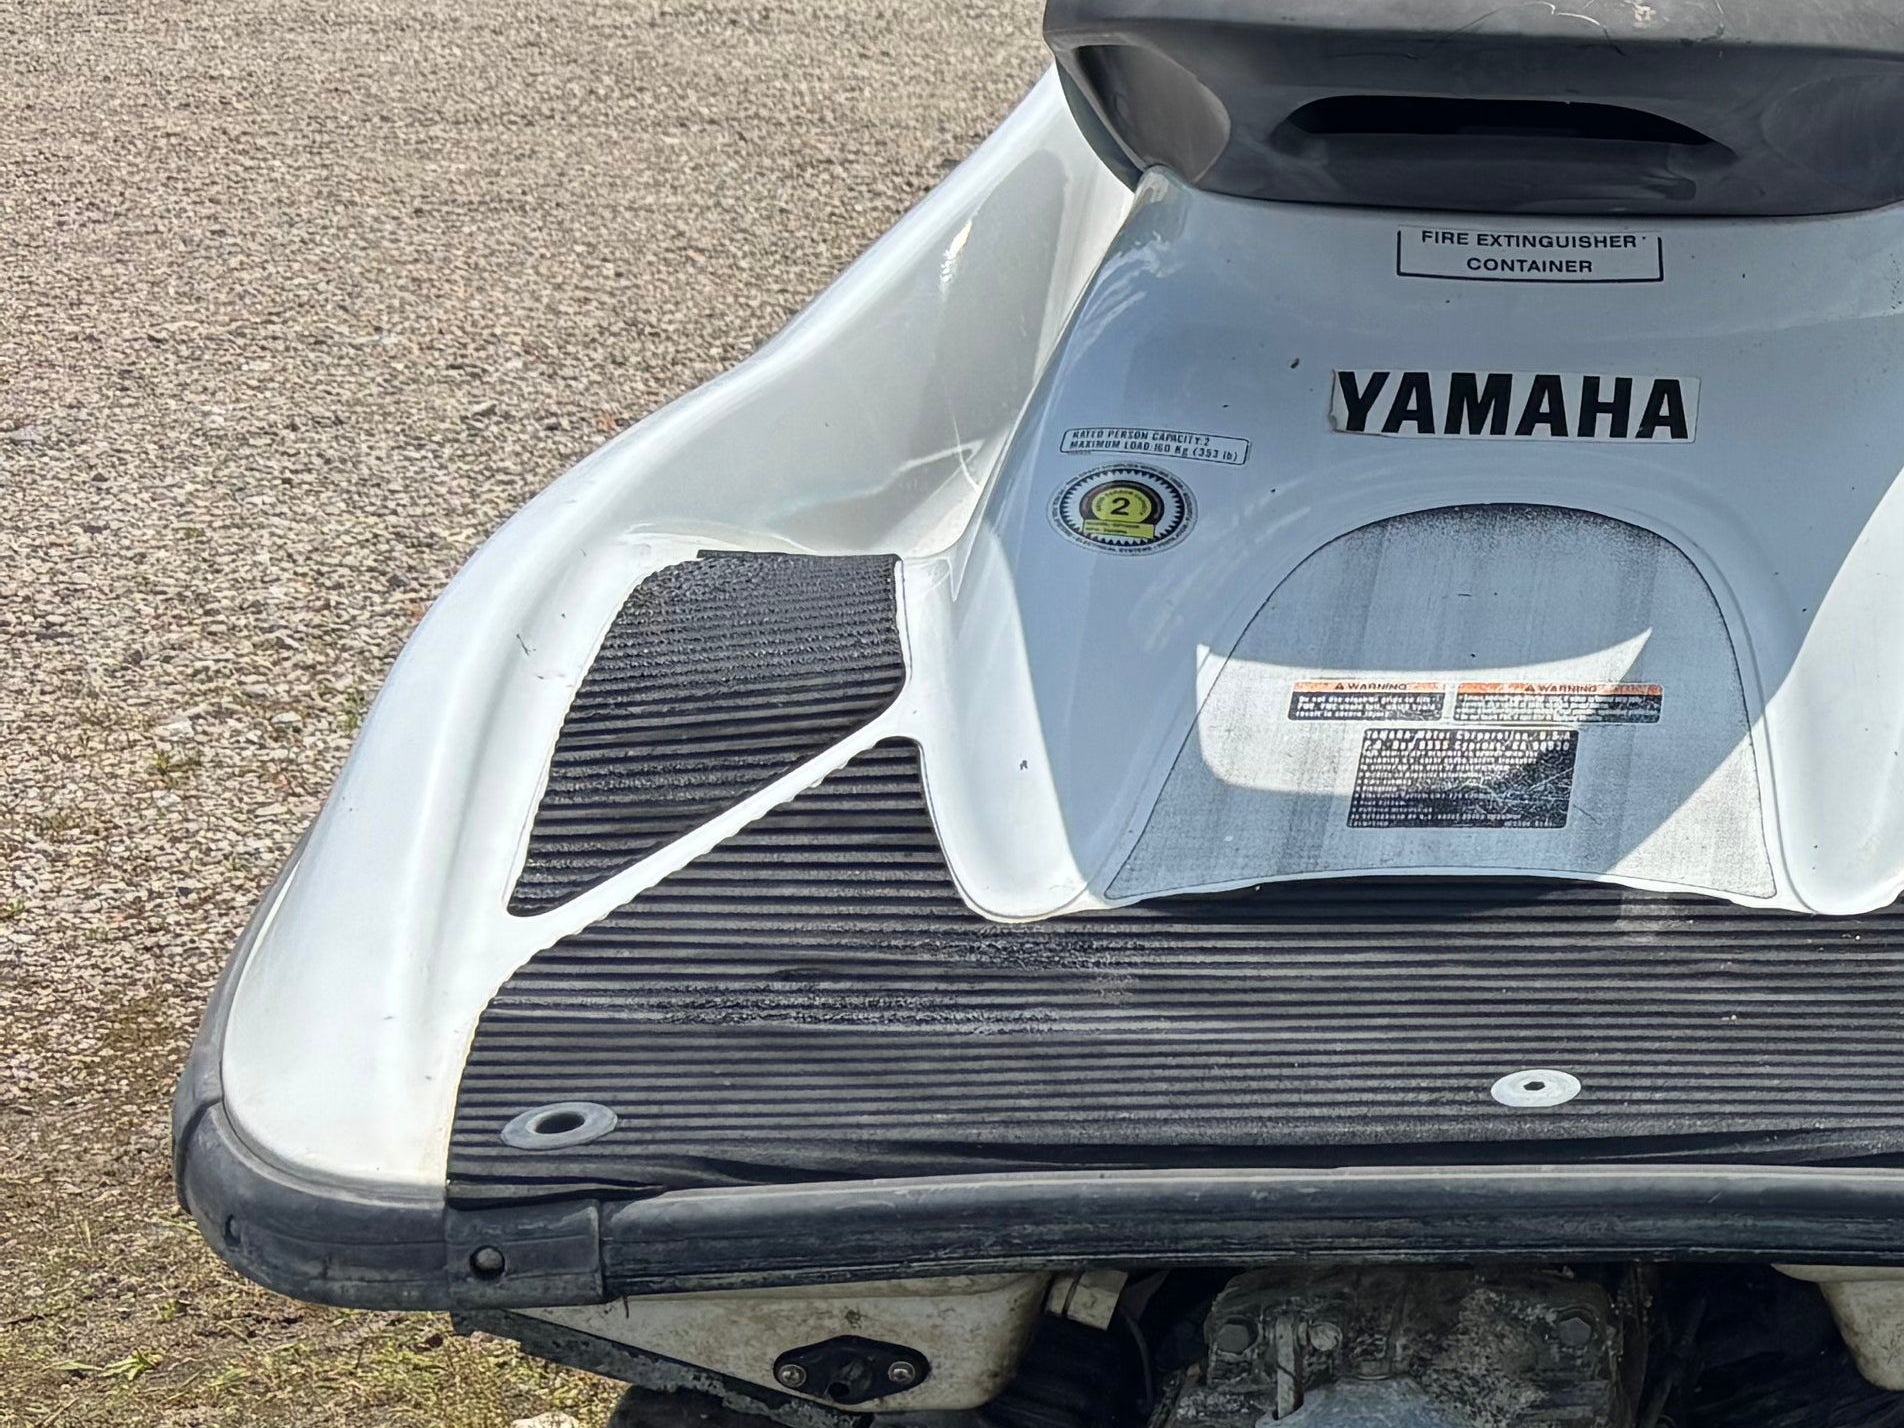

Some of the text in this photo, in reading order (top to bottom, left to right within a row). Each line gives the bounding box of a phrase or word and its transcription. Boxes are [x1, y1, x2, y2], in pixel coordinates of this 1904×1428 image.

[1421, 230, 1637, 249] FIRE EXTINGUISHER
[1466, 257, 1593, 273] CONTAINER
[1338, 371, 1689, 440] YAMAHA
[1072, 430, 1104, 439] RATED
[1107, 431, 1149, 440] PERSON
[1069, 440, 1121, 450] MAXIMUM
[1192, 447, 1219, 459] (353
[1222, 451, 1238, 462] lb)
[1110, 497, 1131, 516] 2
[1540, 684, 1598, 692] WARNING
[1414, 730, 1450, 740] Motor
